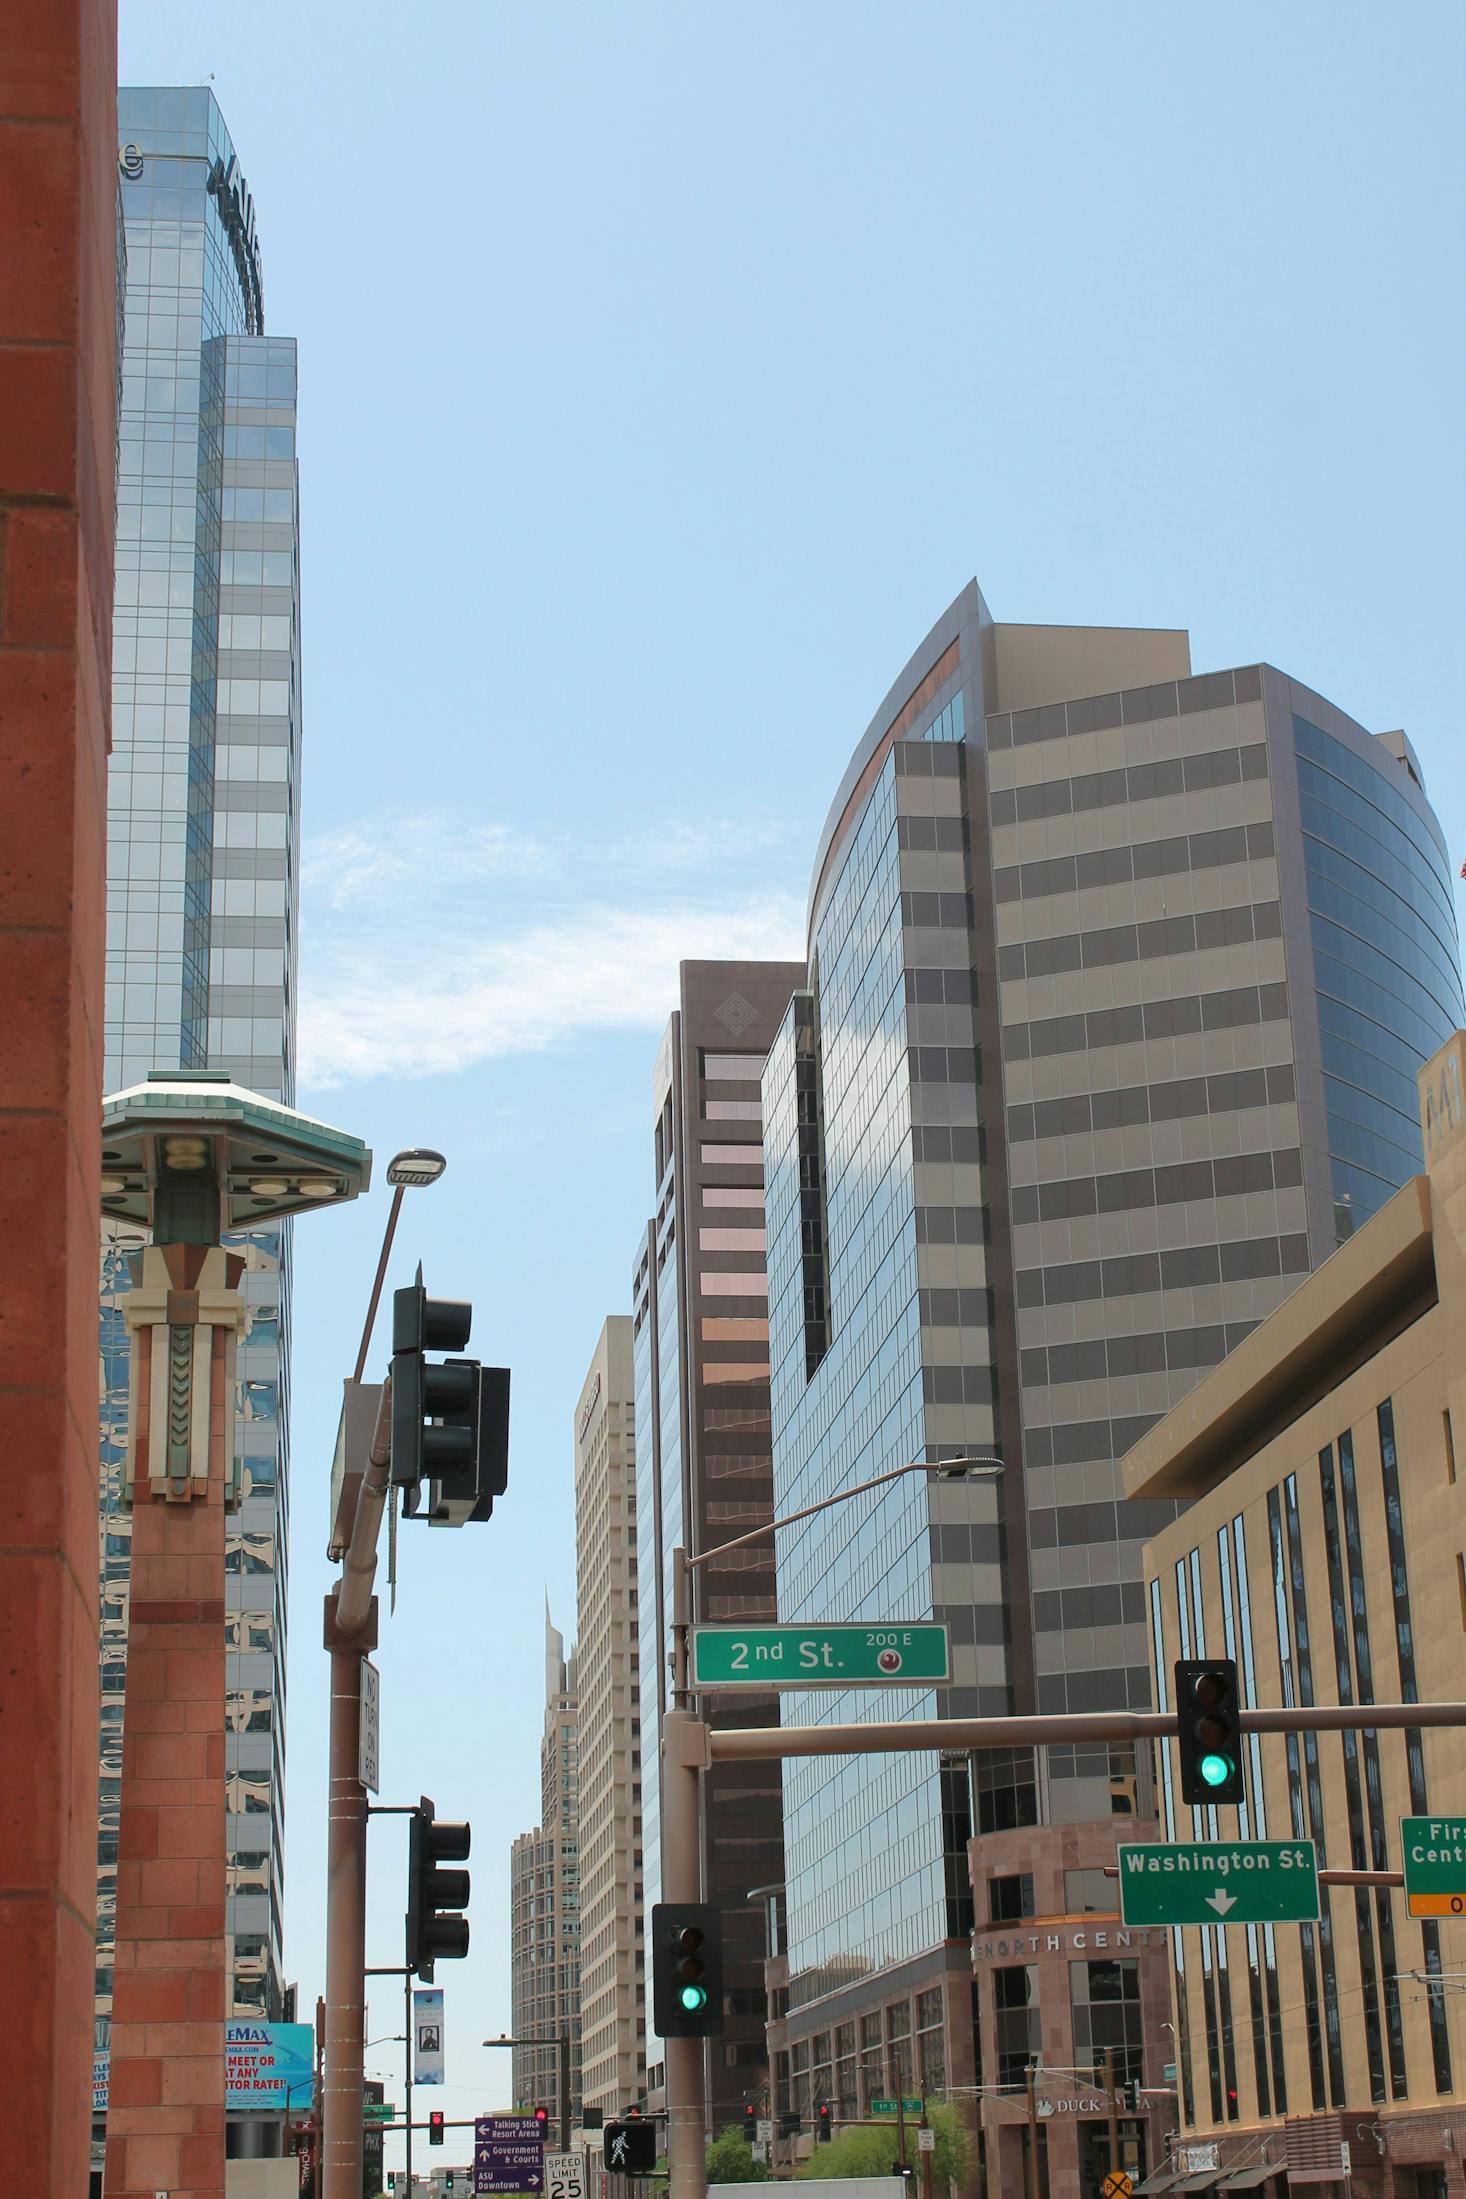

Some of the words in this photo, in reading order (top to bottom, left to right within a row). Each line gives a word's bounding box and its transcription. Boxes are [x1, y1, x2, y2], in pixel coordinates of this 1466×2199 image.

[866, 1633, 897, 1646] 200
[903, 1633, 912, 1645] E
[730, 1642, 783, 1669] 2nd
[799, 1641, 844, 1668] St.
[1411, 1845, 1466, 1862] Cent
[1126, 1851, 1271, 1876] Washington
[1279, 1849, 1311, 1869] St.
[228, 2056, 257, 2066] MEET
[260, 2056, 275, 2066] OR
[237, 2068, 259, 2078] ANY
[1057, 2100, 1100, 2112] DUCK
[494, 2120, 520, 2130] Talking
[522, 2120, 540, 2128] Stick
[492, 2130, 516, 2138] Resort
[518, 2130, 540, 2138] Arena
[492, 2146, 539, 2154] Government
[513, 2155, 539, 2163] Courts
[548, 2158, 581, 2169] SPEED
[478, 2172, 493, 2180] ASU
[552, 2169, 577, 2179] LIMIT
[478, 2181, 520, 2190] Downtown
[550, 2179, 582, 2199] 25
[1105, 2183, 1113, 2192] R
[1123, 2182, 1131, 2190] R
